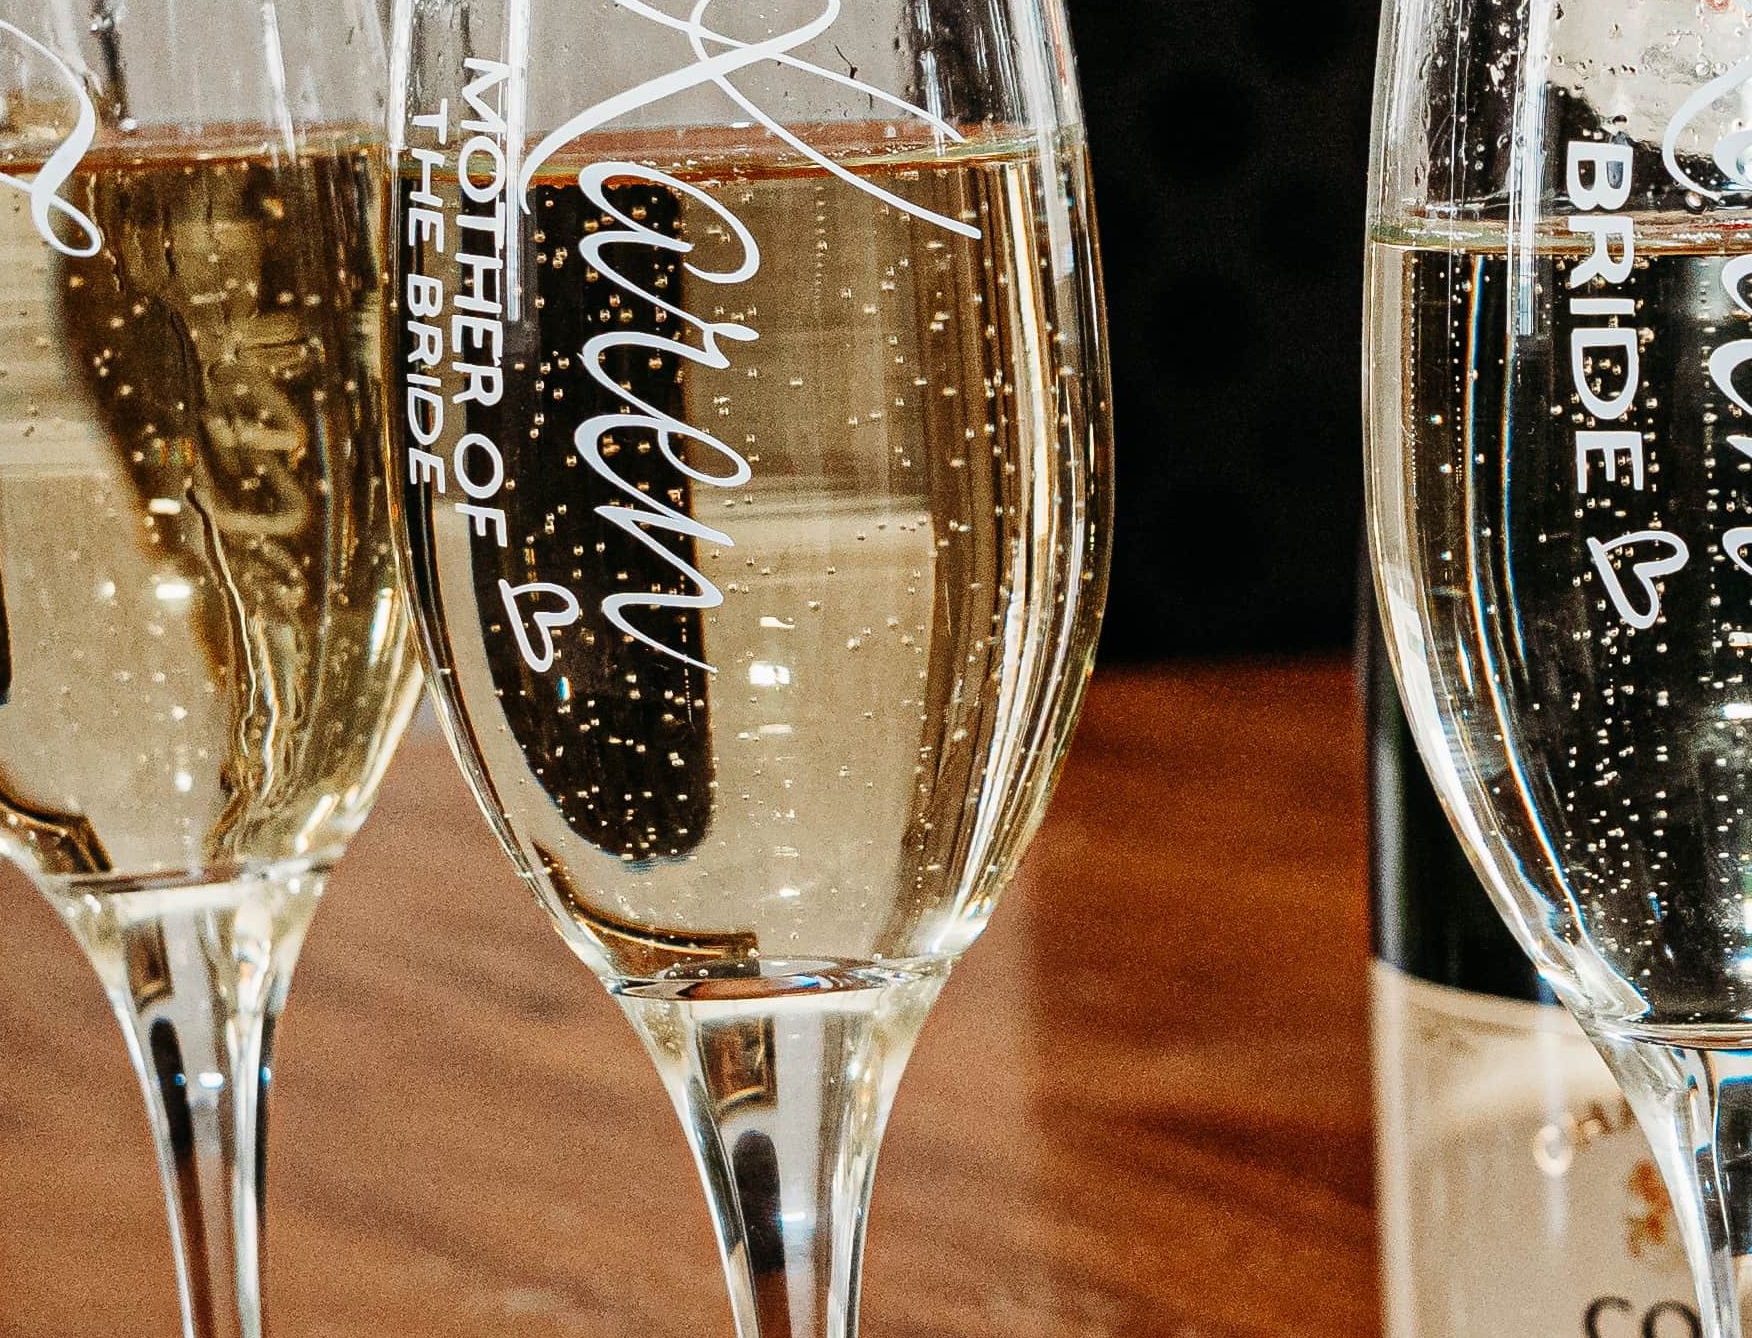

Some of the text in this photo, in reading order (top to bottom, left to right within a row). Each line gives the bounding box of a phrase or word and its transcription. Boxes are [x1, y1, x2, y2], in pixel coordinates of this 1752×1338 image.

[407, 97, 448, 494] THE BRIDE
[452, 57, 512, 548] MOTHER OF
[1566, 140, 1646, 495] BRIDE
